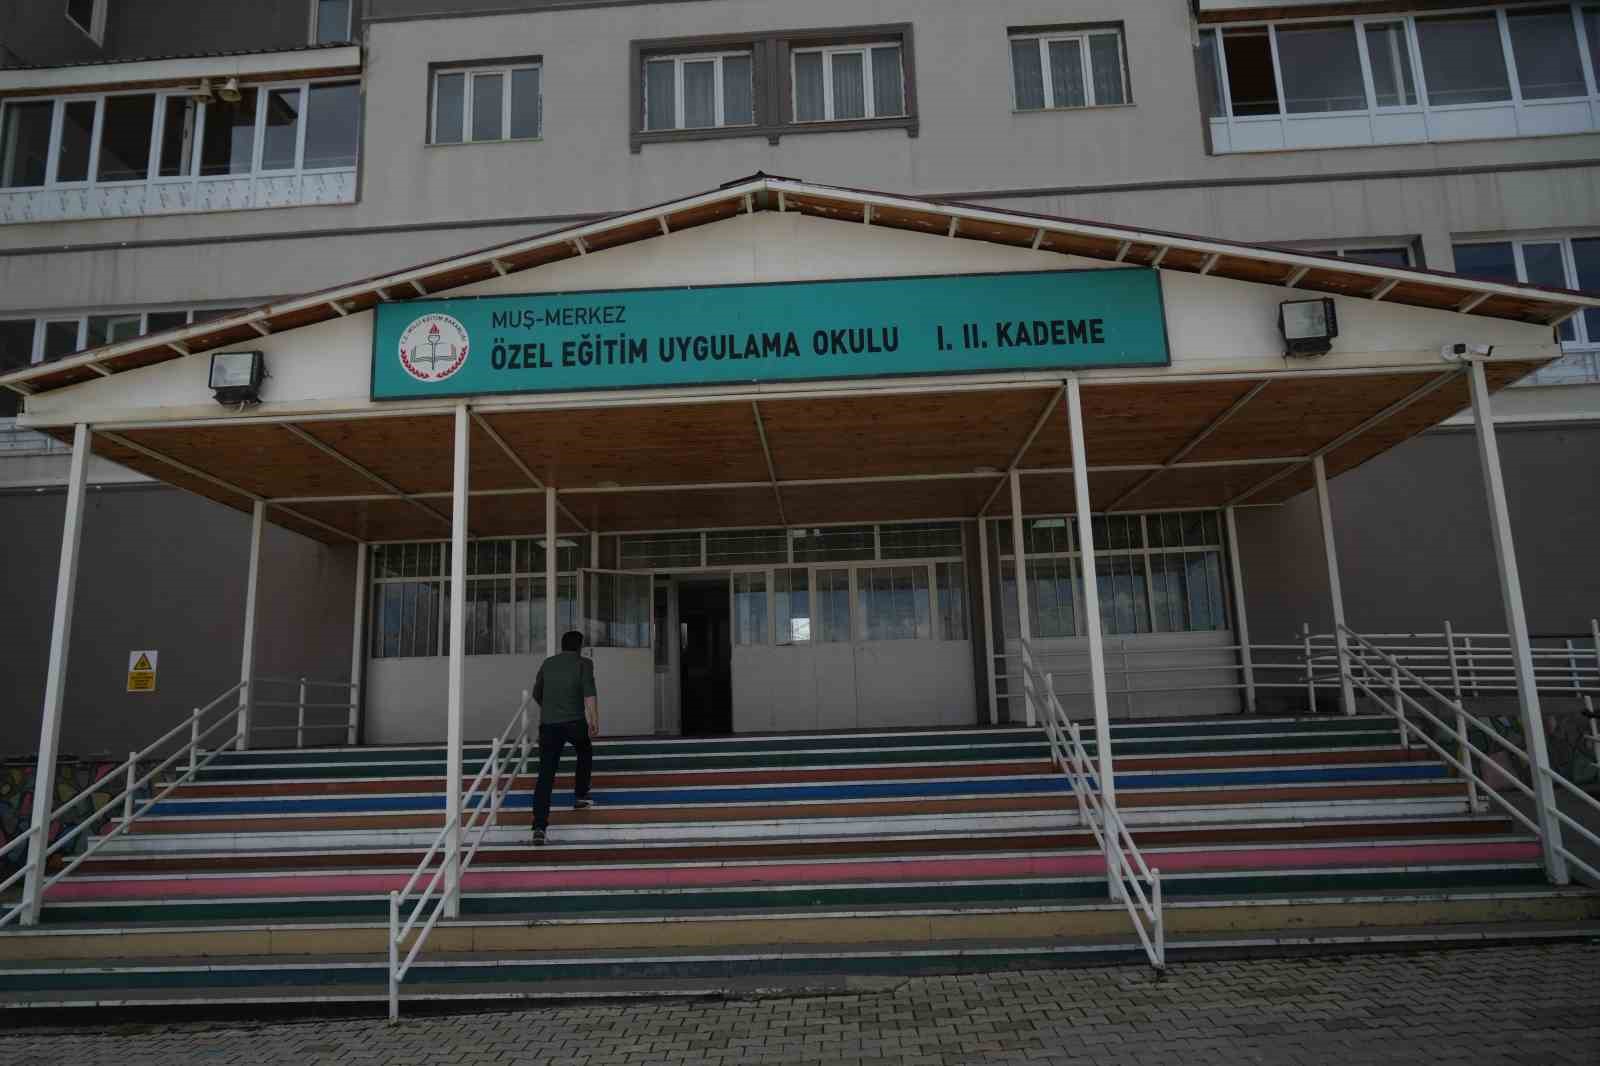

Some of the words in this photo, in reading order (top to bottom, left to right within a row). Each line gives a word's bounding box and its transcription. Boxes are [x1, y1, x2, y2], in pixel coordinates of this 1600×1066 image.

[492, 306, 626, 330] MUŞ-MERKEZ
[491, 337, 552, 370] ÖZEL
[562, 333, 648, 367] EĞİTİM
[659, 332, 801, 362] UYGULAMA
[813, 326, 898, 356] OKULU
[937, 325, 953, 352] I.
[963, 323, 988, 350] II.
[996, 318, 1105, 348] KADEME
